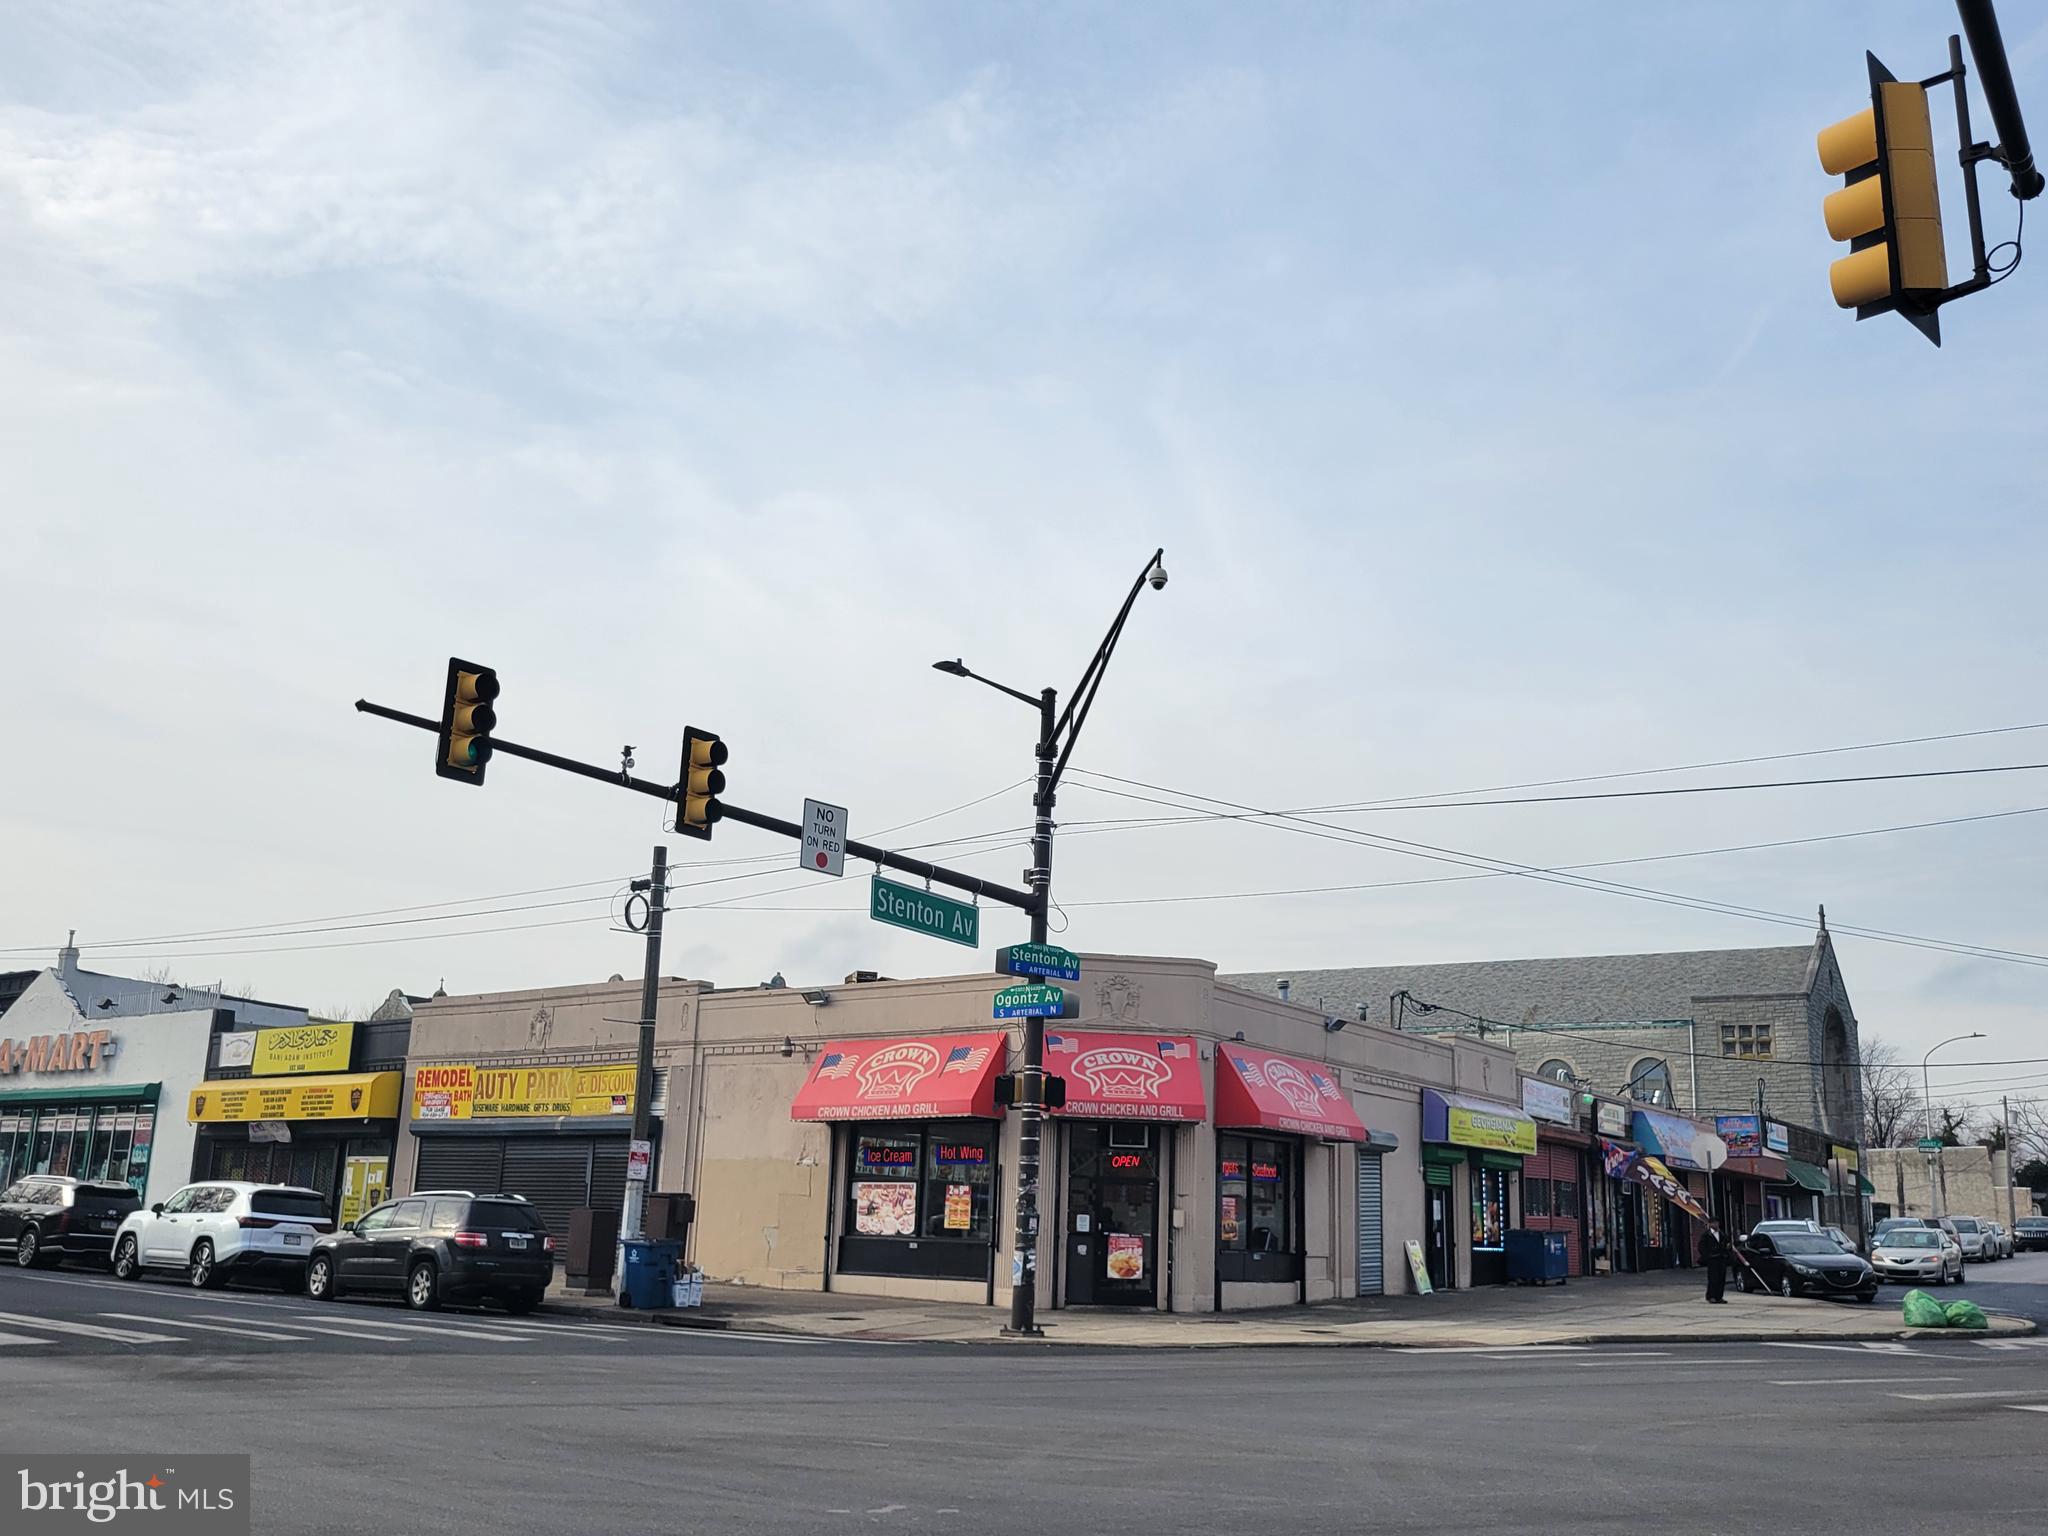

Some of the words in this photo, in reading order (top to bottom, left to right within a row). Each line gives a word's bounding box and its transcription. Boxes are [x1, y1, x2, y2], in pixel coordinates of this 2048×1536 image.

[816, 807, 834, 823] NO
[813, 823, 836, 838] TURN
[807, 836, 819, 849] ON
[822, 839, 840, 853] RED
[877, 888, 944, 929] Stenton
[952, 913, 973, 937] Av
[1012, 948, 1058, 966] Stenton
[1064, 956, 1078, 969] Av
[1016, 962, 1020, 971] E
[1028, 966, 1060, 977] ARTERIAL
[1066, 970, 1074, 979] W
[996, 993, 1038, 1008] Ogontz
[1044, 990, 1060, 1002] Av
[999, 1008, 1004, 1017] S
[1012, 1008, 1043, 1016] ARTERIAL
[1050, 1005, 1056, 1014] N
[23, 1030, 111, 1073] MART
[870, 1047, 930, 1066] CROWN
[1083, 1050, 1158, 1070] CROWN
[416, 1068, 472, 1088] REMODEL
[475, 1072, 518, 1100] AUTY
[527, 1071, 573, 1100] PARK
[576, 1076, 586, 1094] &
[454, 1090, 472, 1102] BATH
[501, 1104, 530, 1112] HARDWARE
[534, 1102, 549, 1112] GIFTS
[552, 1102, 571, 1112] DRUGS
[818, 1106, 850, 1118] CROWN
[852, 1104, 890, 1117] CHICKEN
[892, 1104, 911, 1115] AND
[912, 1102, 940, 1114] GRILL
[1066, 1101, 1098, 1114] CROWN
[1100, 1102, 1138, 1116] CHICKEN
[1139, 1104, 1158, 1116] AND
[1159, 1105, 1184, 1118] GRILL
[1279, 1117, 1300, 1130] CROWN
[1300, 1120, 1324, 1134] CHICKEN
[1324, 1123, 1335, 1136] AND
[1336, 1126, 1352, 1138] GRILL
[867, 1150, 882, 1162] Ice
[883, 1148, 913, 1162] Cream
[940, 1146, 956, 1160] Hot
[960, 1146, 984, 1162] Wing
[1112, 1156, 1140, 1168] OPEN
[1252, 1162, 1277, 1178] Seafood
